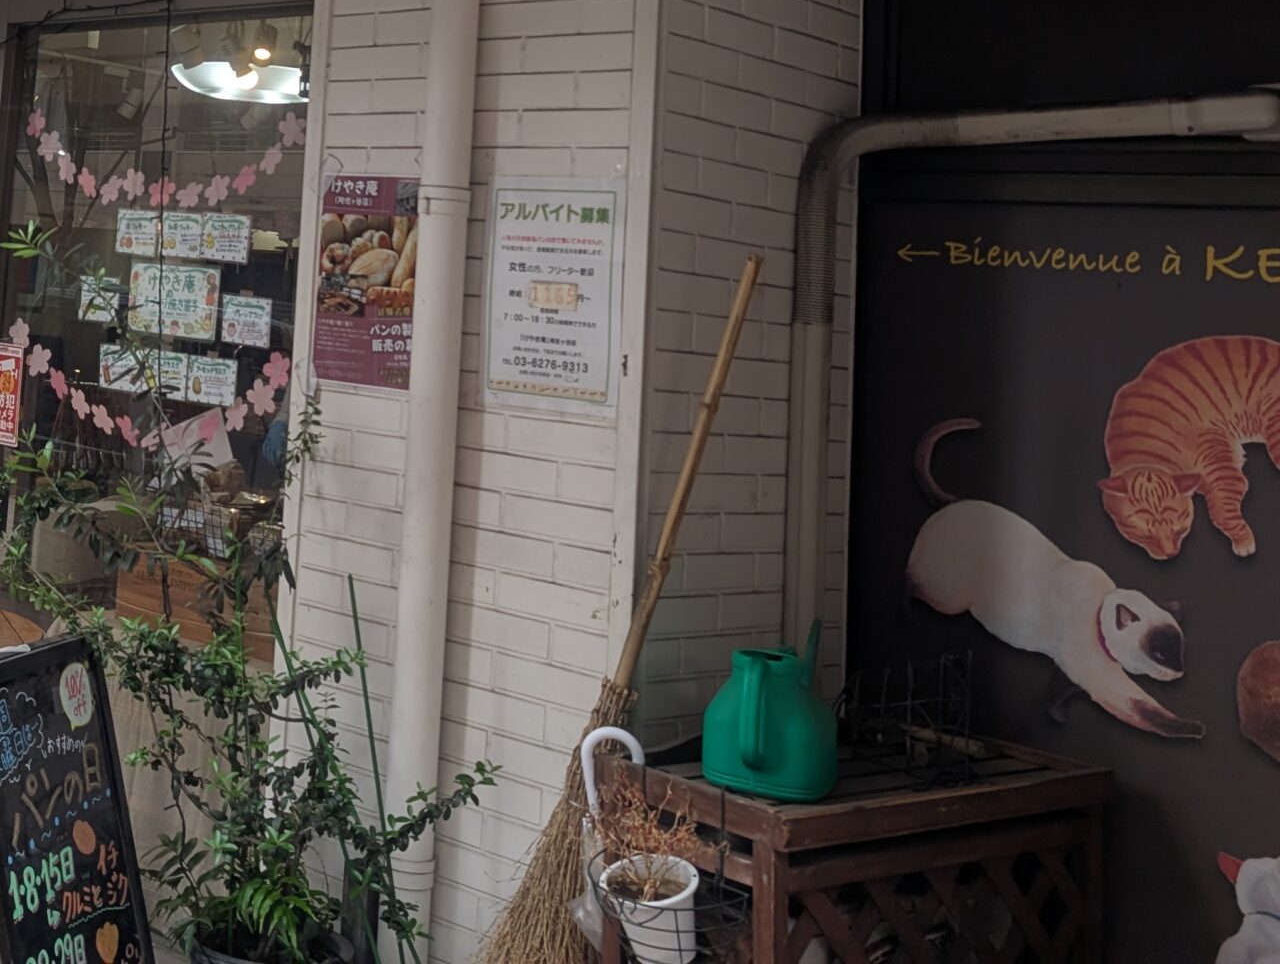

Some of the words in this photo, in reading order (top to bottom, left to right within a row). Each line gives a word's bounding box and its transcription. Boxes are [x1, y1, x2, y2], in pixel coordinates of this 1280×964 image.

[331, 179, 378, 196] けやき庵
[500, 202, 610, 224] アルバイト募集
[944, 237, 1141, 274] Bienvenue
[1161, 245, 1181, 276] à
[148, 274, 195, 293] けやき庵
[513, 356, 589, 373] 03-6276-9313
[12, 742, 102, 847] パンの日
